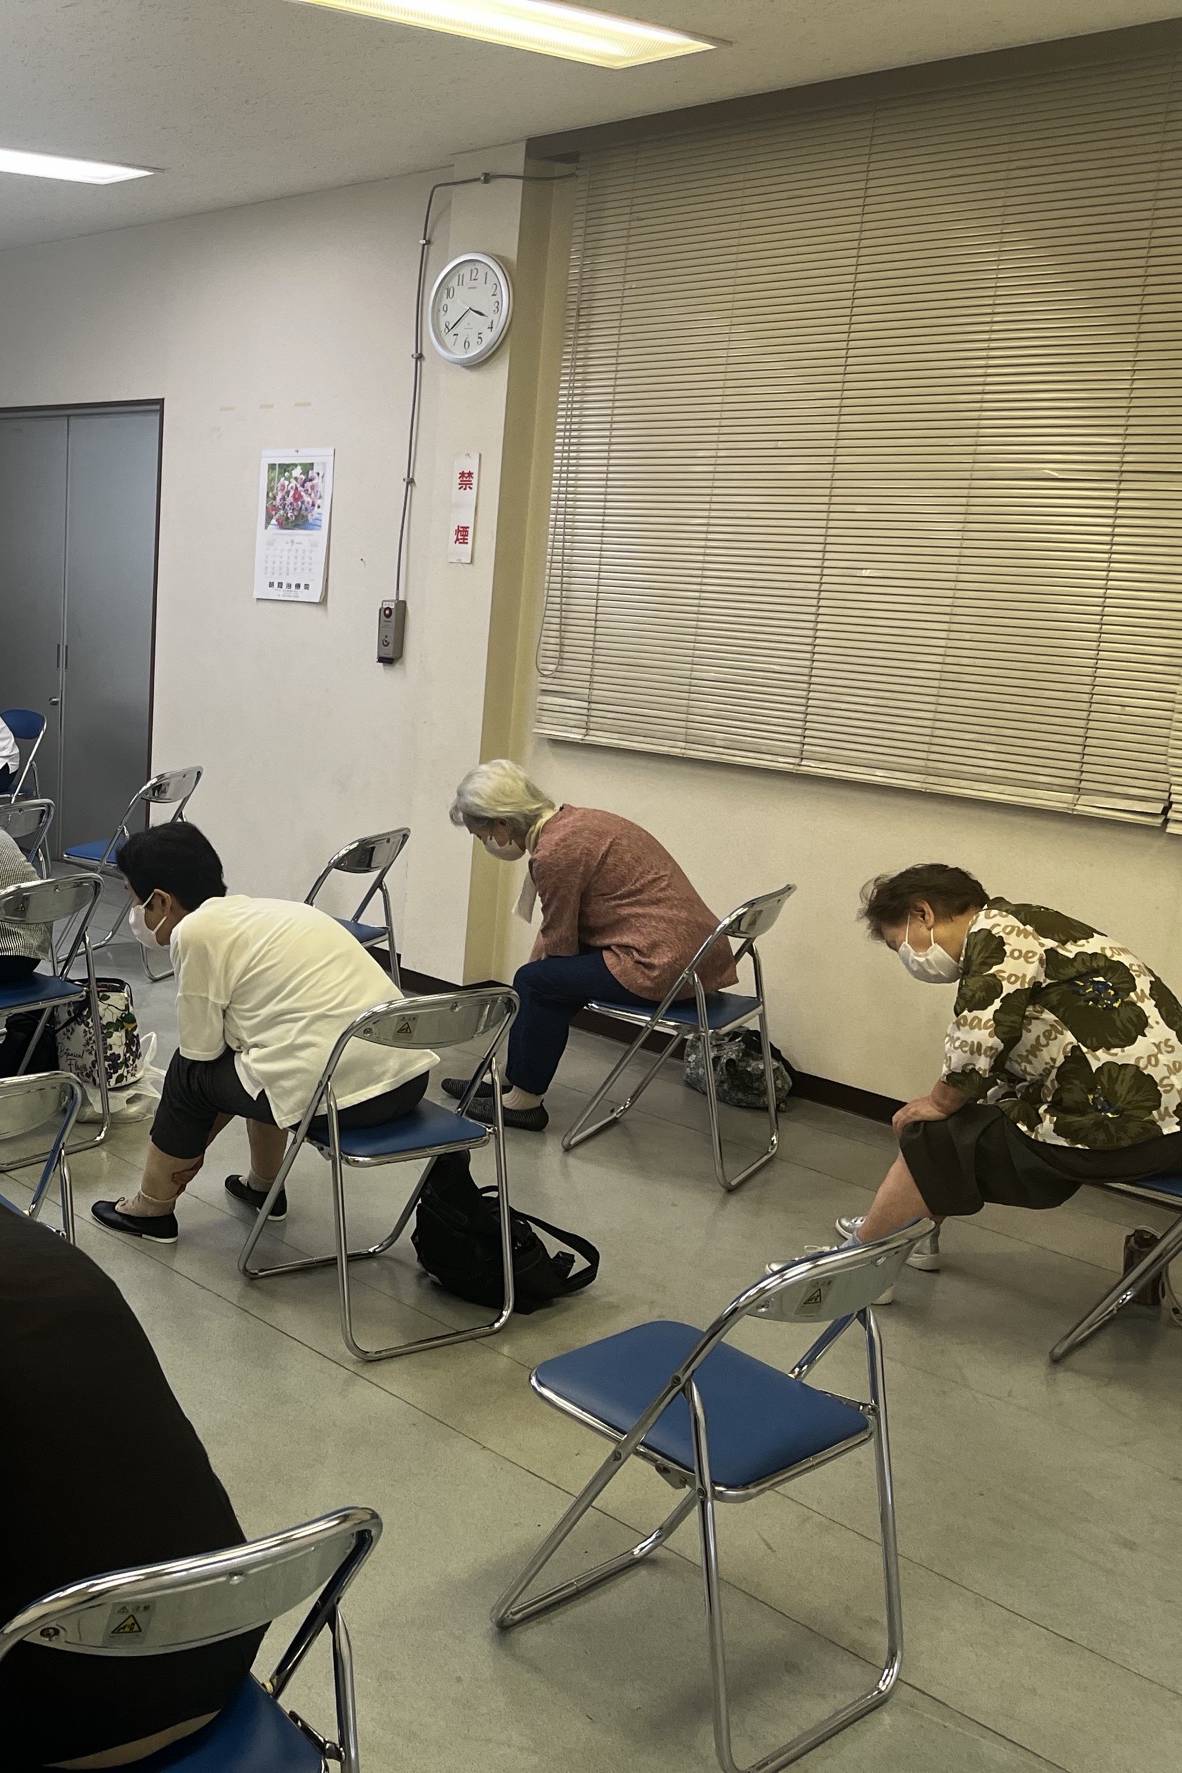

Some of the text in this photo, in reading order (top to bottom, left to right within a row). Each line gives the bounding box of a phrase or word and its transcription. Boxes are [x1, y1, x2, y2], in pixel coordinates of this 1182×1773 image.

[457, 273, 464, 286] 11
[469, 268, 479, 281] 12
[484, 271, 488, 284] 1
[446, 286, 455, 299] 10
[492, 283, 498, 296] 2
[442, 304, 448, 317] 9
[493, 301, 499, 314] 3
[487, 319, 494, 332] 4
[453, 333, 458, 347] 7
[464, 336, 470, 350] 6
[477, 332, 483, 345] 5
[454, 469, 474, 546] 禁煙
